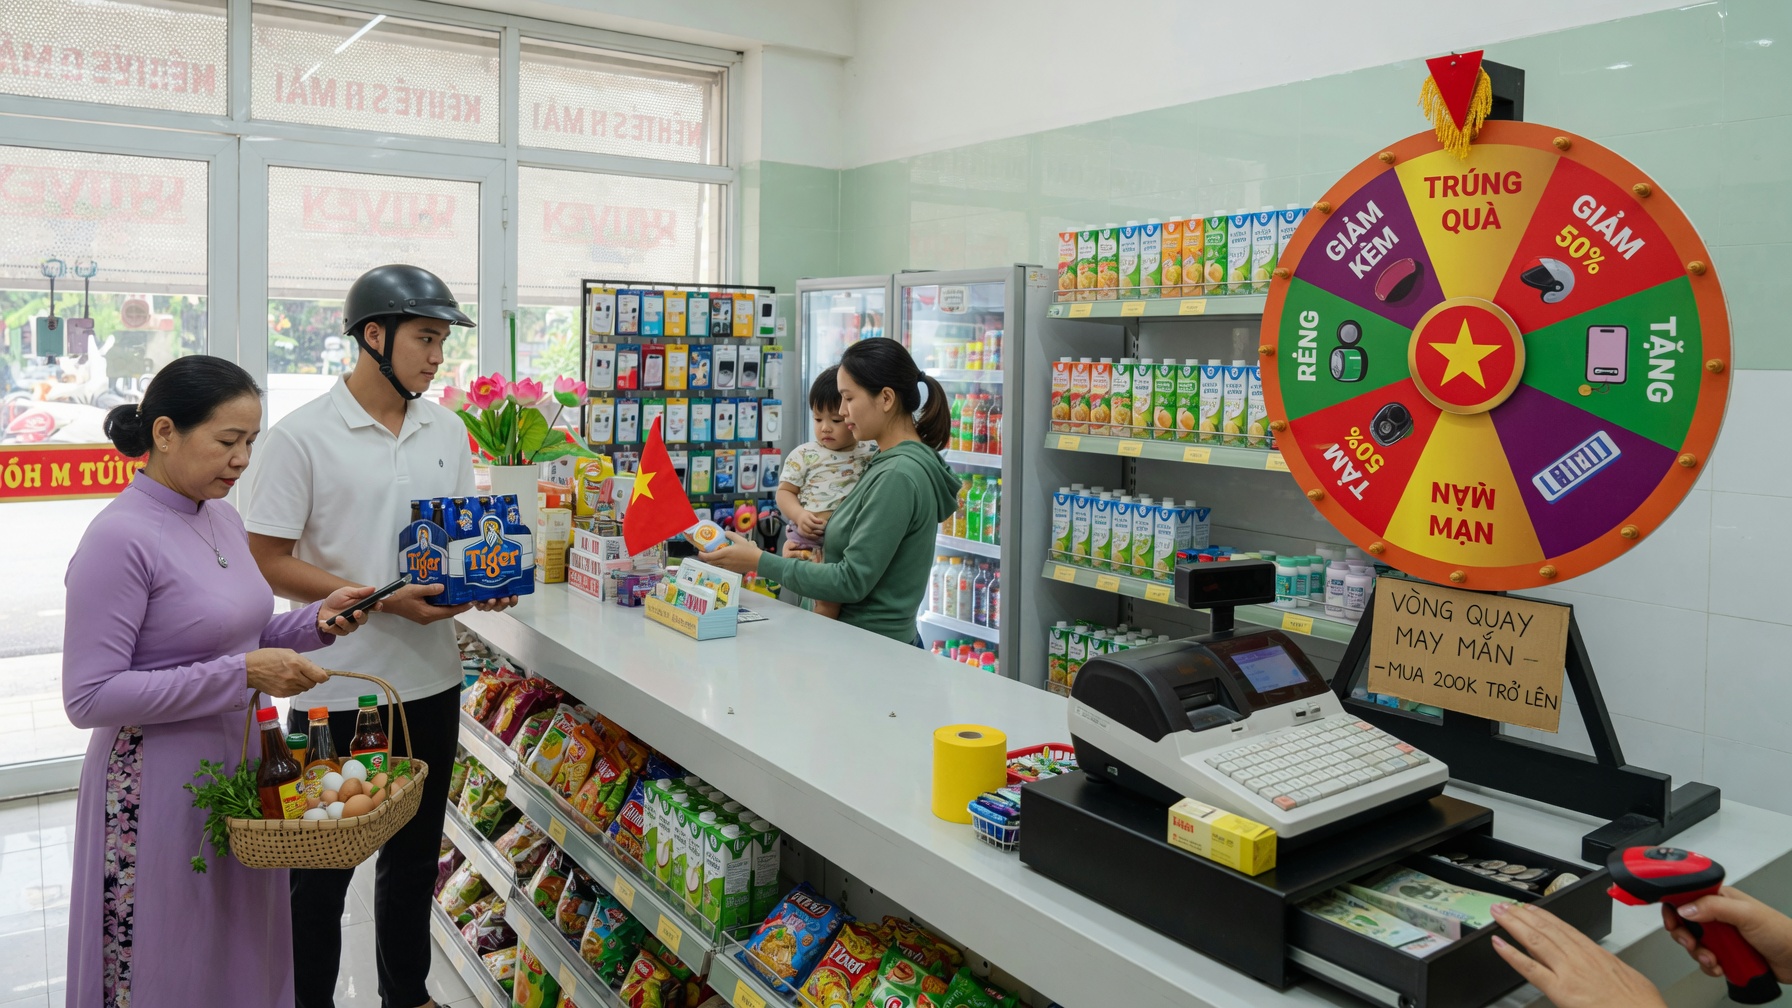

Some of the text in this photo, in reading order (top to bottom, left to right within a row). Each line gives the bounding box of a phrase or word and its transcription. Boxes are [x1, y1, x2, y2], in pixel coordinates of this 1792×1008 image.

[1423, 167, 1523, 199] TRÚNG
[1325, 199, 1385, 262] GIẢM
[1441, 201, 1502, 235] QUÀ
[1572, 194, 1646, 261] GIẢM
[1555, 224, 1606, 275] 50%
[1642, 315, 1685, 404] TẶNG
[1344, 426, 1385, 474] 50%
[50, 462, 71, 487] M
[407, 550, 441, 579] Tiger
[465, 545, 520, 578] Tiger
[1391, 588, 1453, 622] VÒNG
[1466, 604, 1534, 638] QUAY
[1395, 625, 1444, 654] MAY
[1457, 630, 1514, 666] MẮN
[1433, 671, 1478, 695] 200K
[1486, 680, 1521, 702] TRỞ
[1525, 686, 1558, 711] LÊN
